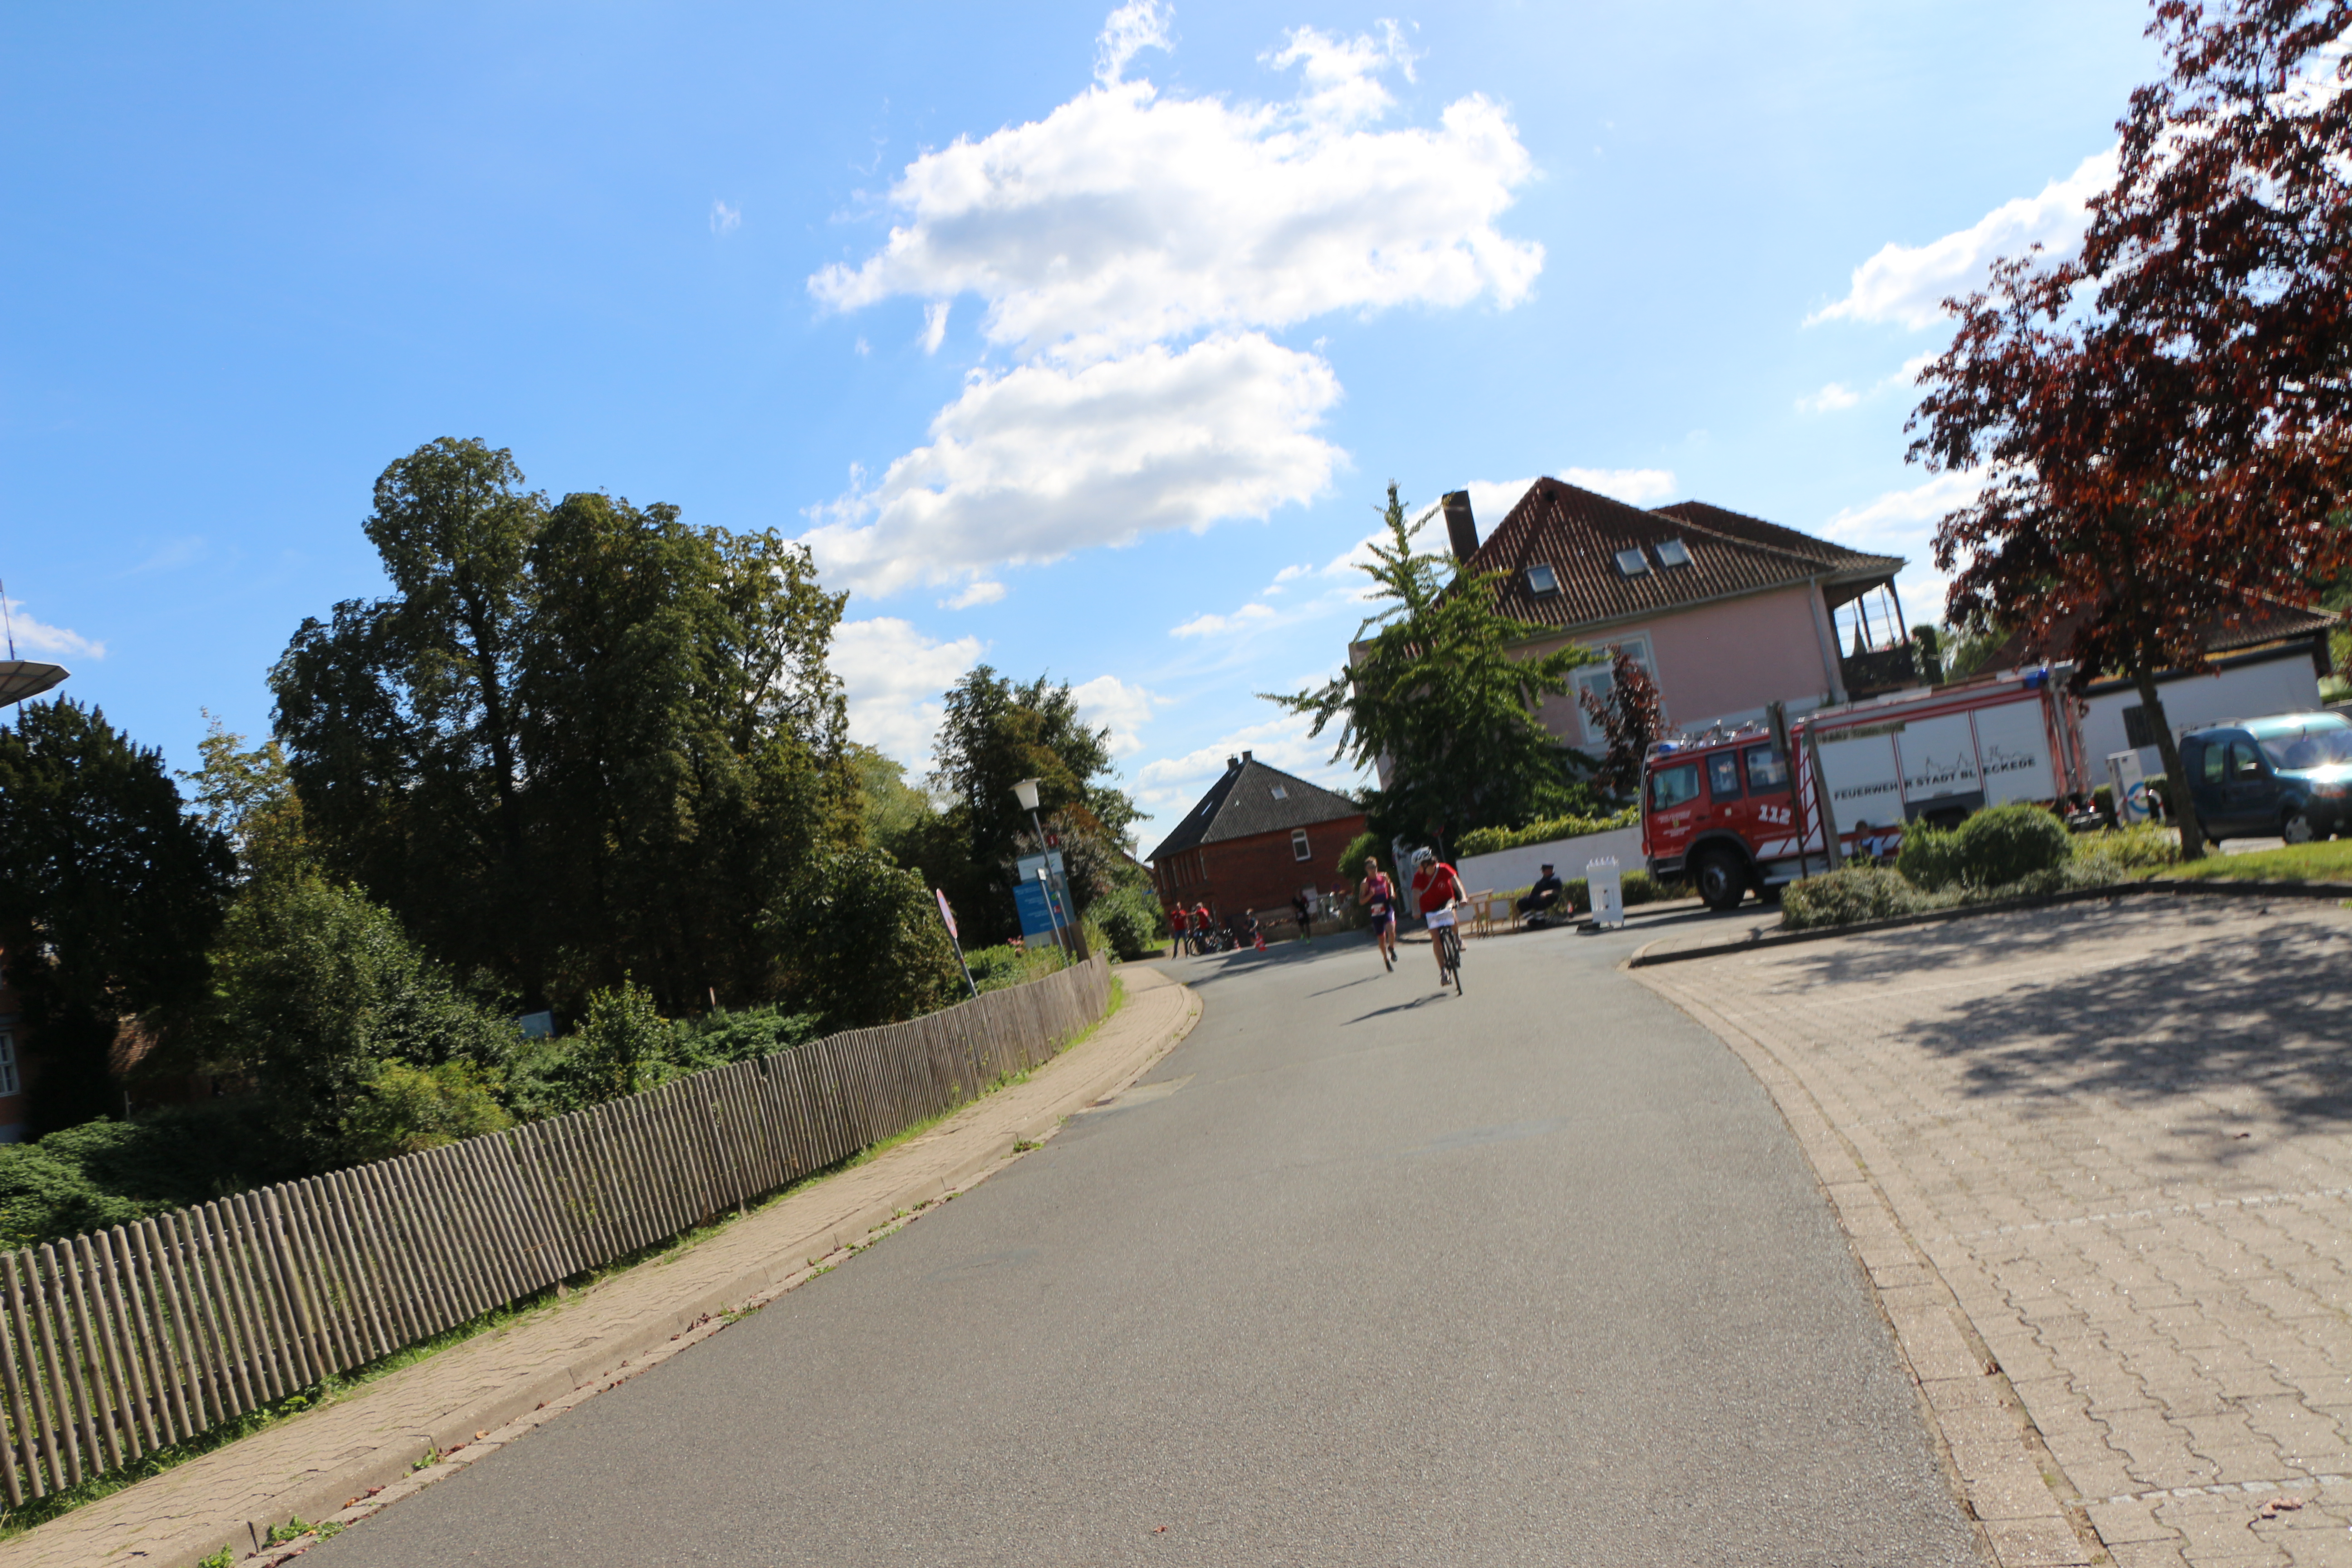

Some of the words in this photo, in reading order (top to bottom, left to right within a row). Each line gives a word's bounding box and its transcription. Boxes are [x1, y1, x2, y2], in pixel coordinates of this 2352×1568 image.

[1834, 778, 1912, 801] FEUERWEHR
[1916, 773, 1955, 788] STADT
[1960, 757, 2036, 781] BLECKEDE
[1758, 804, 1791, 825] 112
